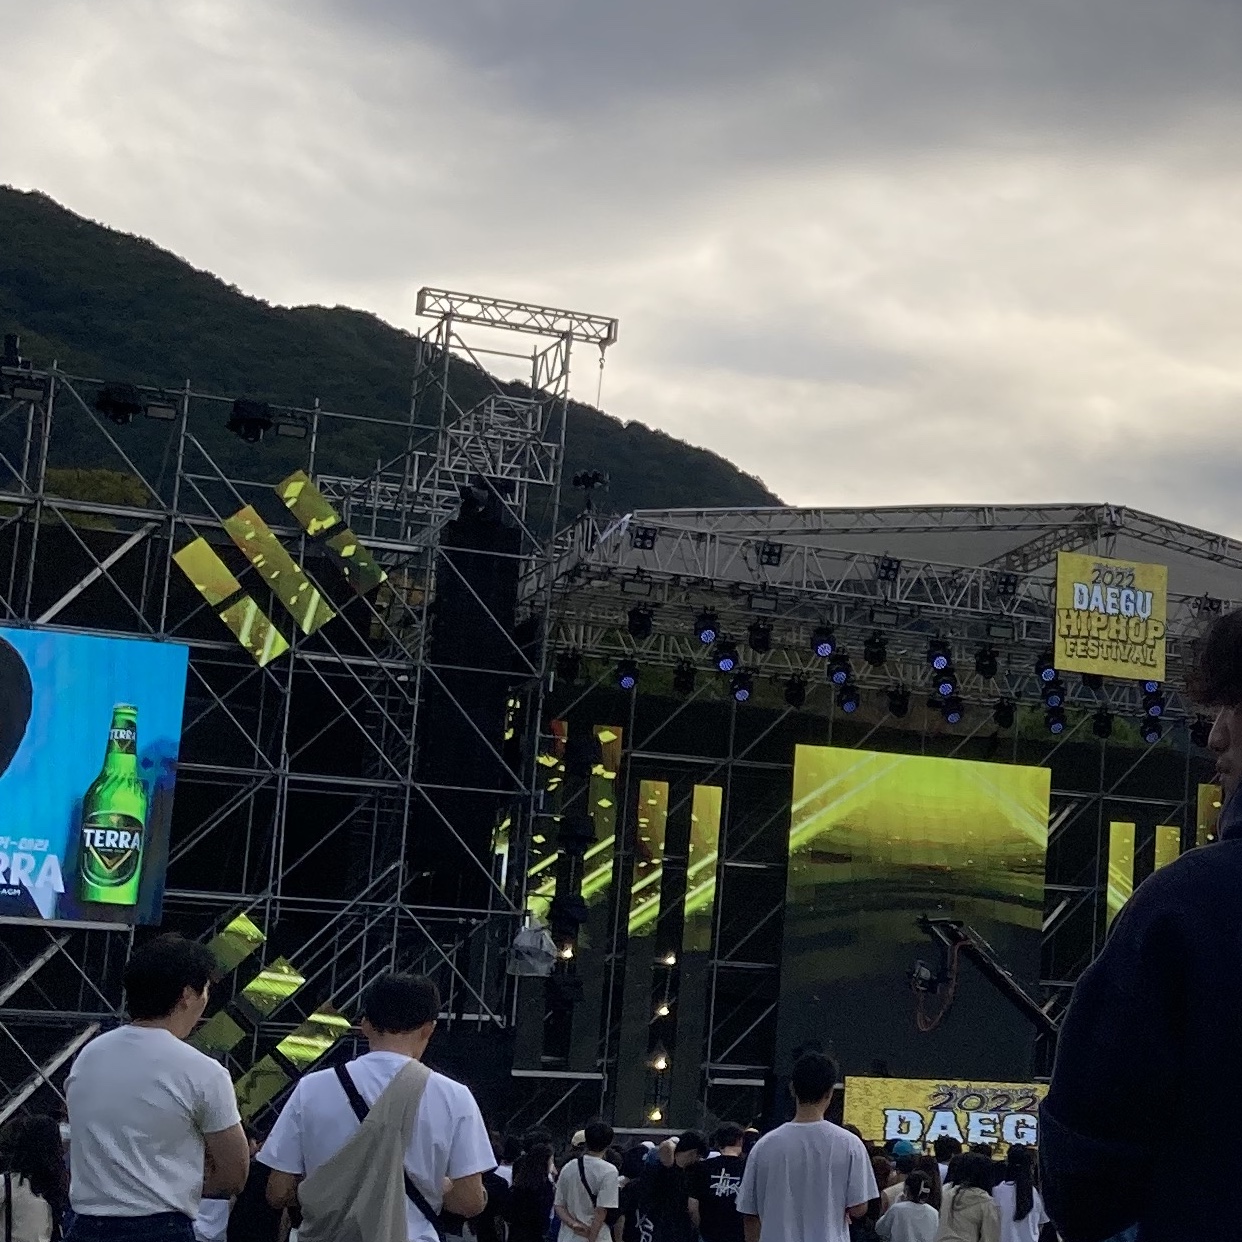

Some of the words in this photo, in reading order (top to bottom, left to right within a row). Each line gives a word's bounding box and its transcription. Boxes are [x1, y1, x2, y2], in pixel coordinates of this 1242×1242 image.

[1091, 568, 1136, 589] 2022
[1072, 582, 1153, 622] DAEGU
[1057, 608, 1166, 646] HIPHOP
[1064, 637, 1157, 667] FESTIVAL
[83, 828, 141, 851] TERRA
[928, 1091, 1039, 1112] 2022
